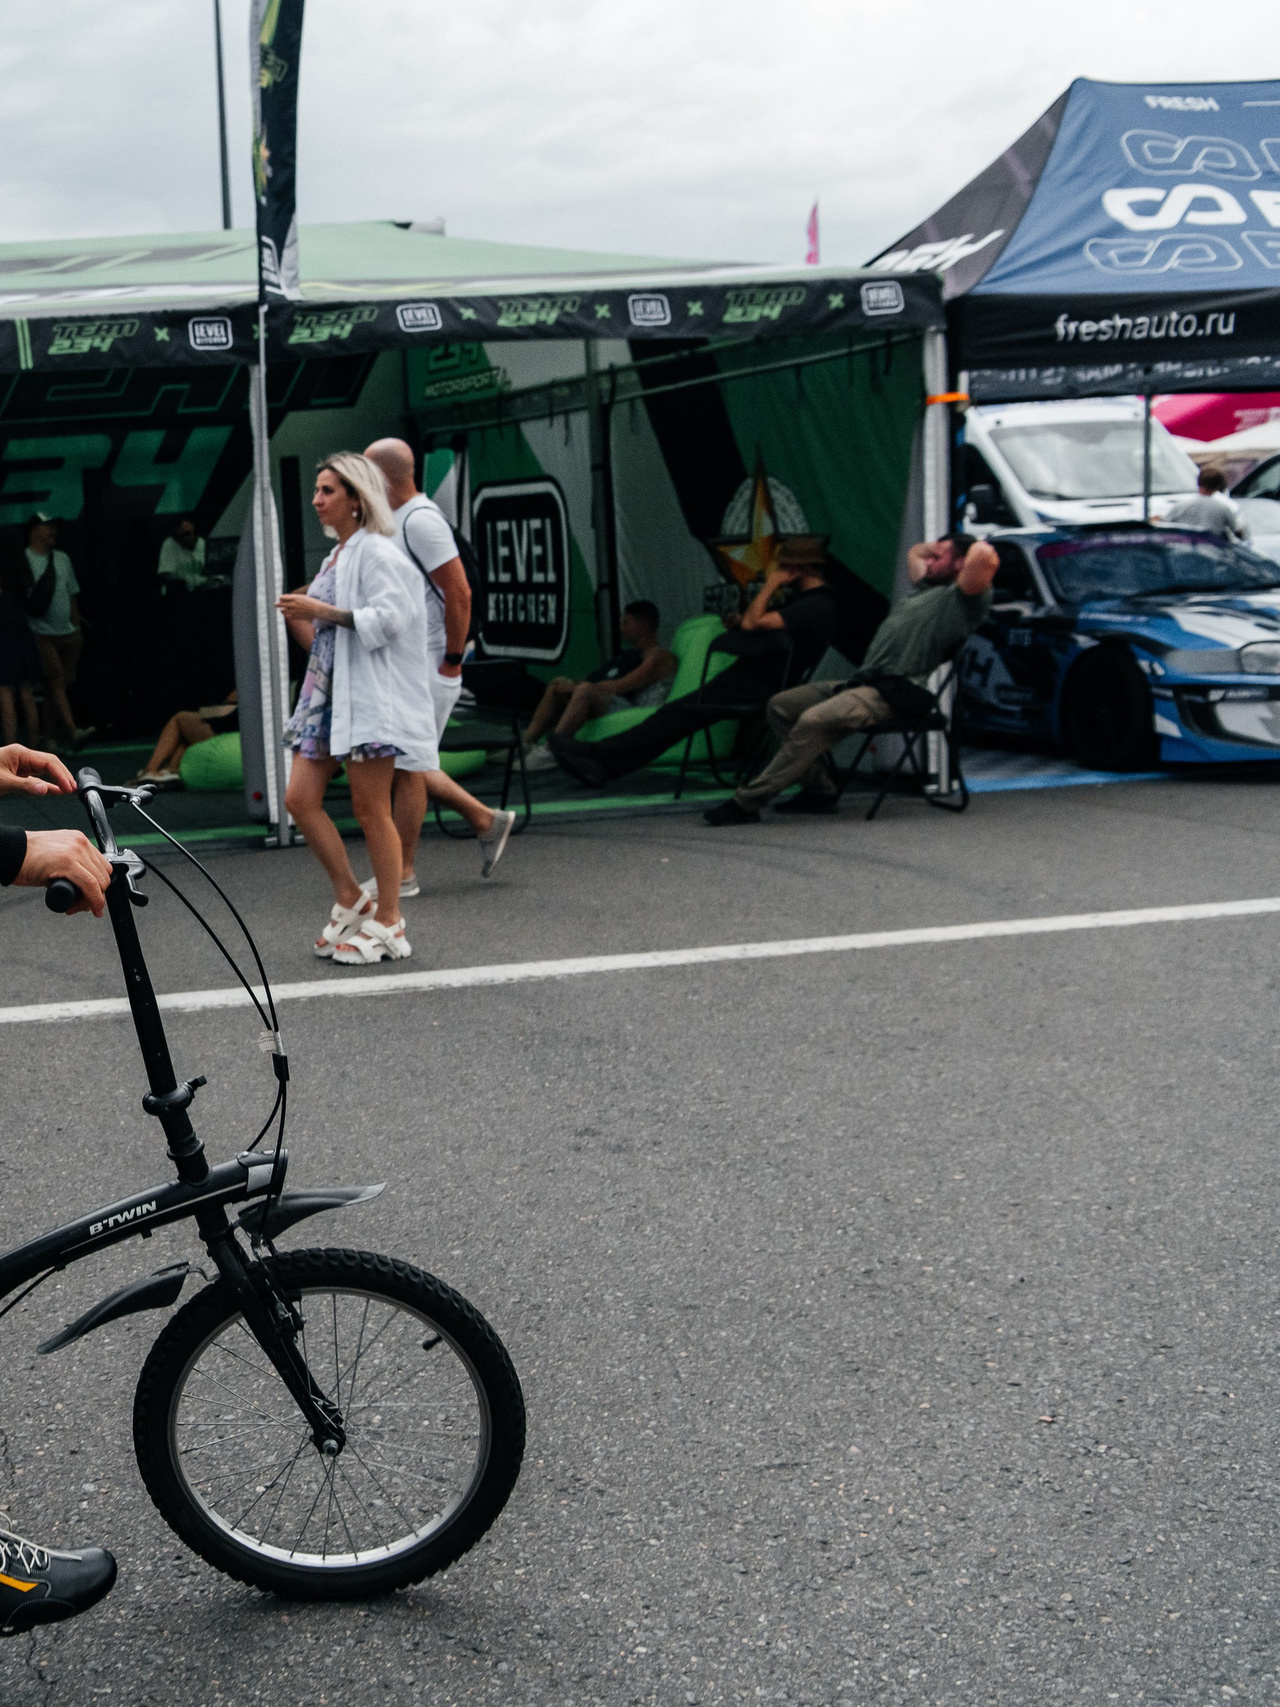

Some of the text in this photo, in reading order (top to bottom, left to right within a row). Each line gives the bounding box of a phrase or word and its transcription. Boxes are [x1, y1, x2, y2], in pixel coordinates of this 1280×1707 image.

[1144, 95, 1220, 112] FRESH
[52, 319, 140, 341] TEAM
[194, 323, 227, 338] LEVEL
[287, 323, 354, 344] 234
[1054, 311, 1236, 343] freshauto.ru
[47, 336, 115, 356] 234
[486, 518, 557, 583] LEVEL
[487, 592, 558, 625] KITCHEN
[89, 1200, 157, 1236] B'TWIN
